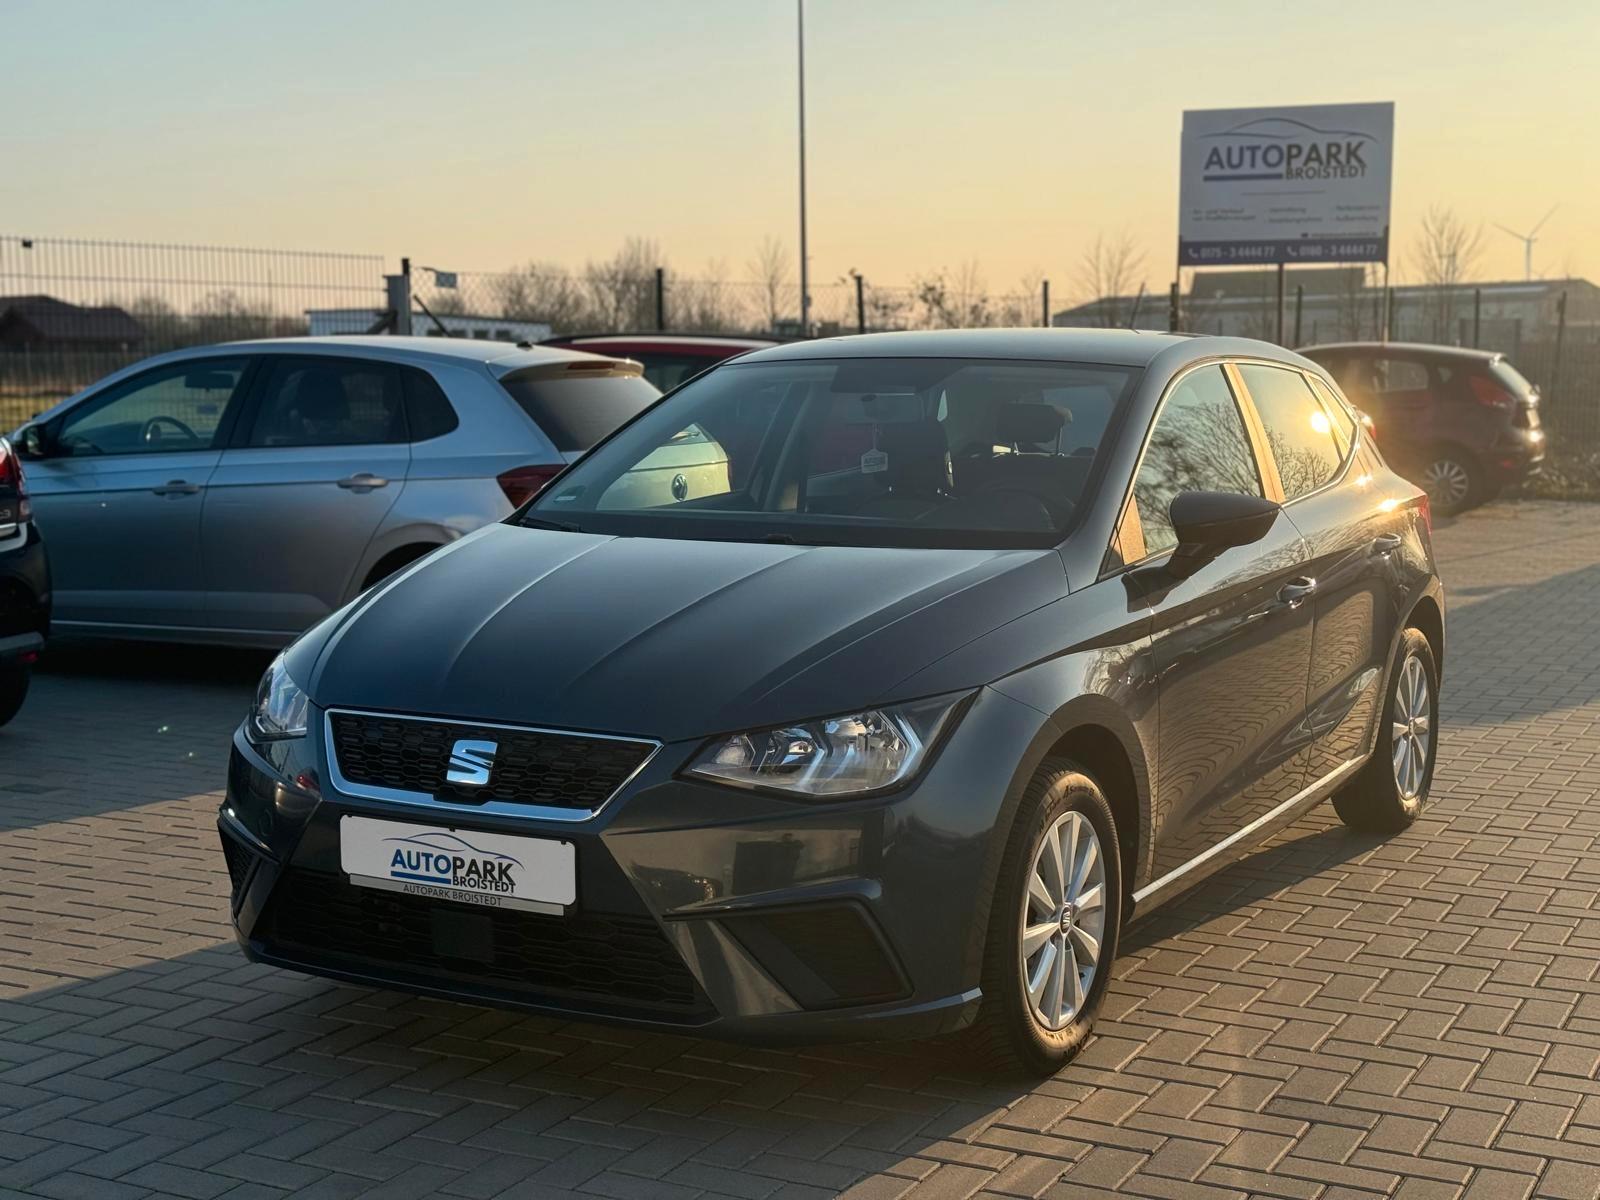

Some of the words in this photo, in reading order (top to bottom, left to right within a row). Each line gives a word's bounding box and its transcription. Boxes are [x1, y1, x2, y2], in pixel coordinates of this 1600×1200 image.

[1204, 141, 1366, 171] AUTOPARK
[1285, 164, 1367, 181] BROISTEDT
[391, 848, 516, 886] AUTOPARK
[403, 883, 451, 899] AUTOPARK
[452, 891, 503, 907] BROISTEDT
[452, 876, 517, 894] BROISTEDT
